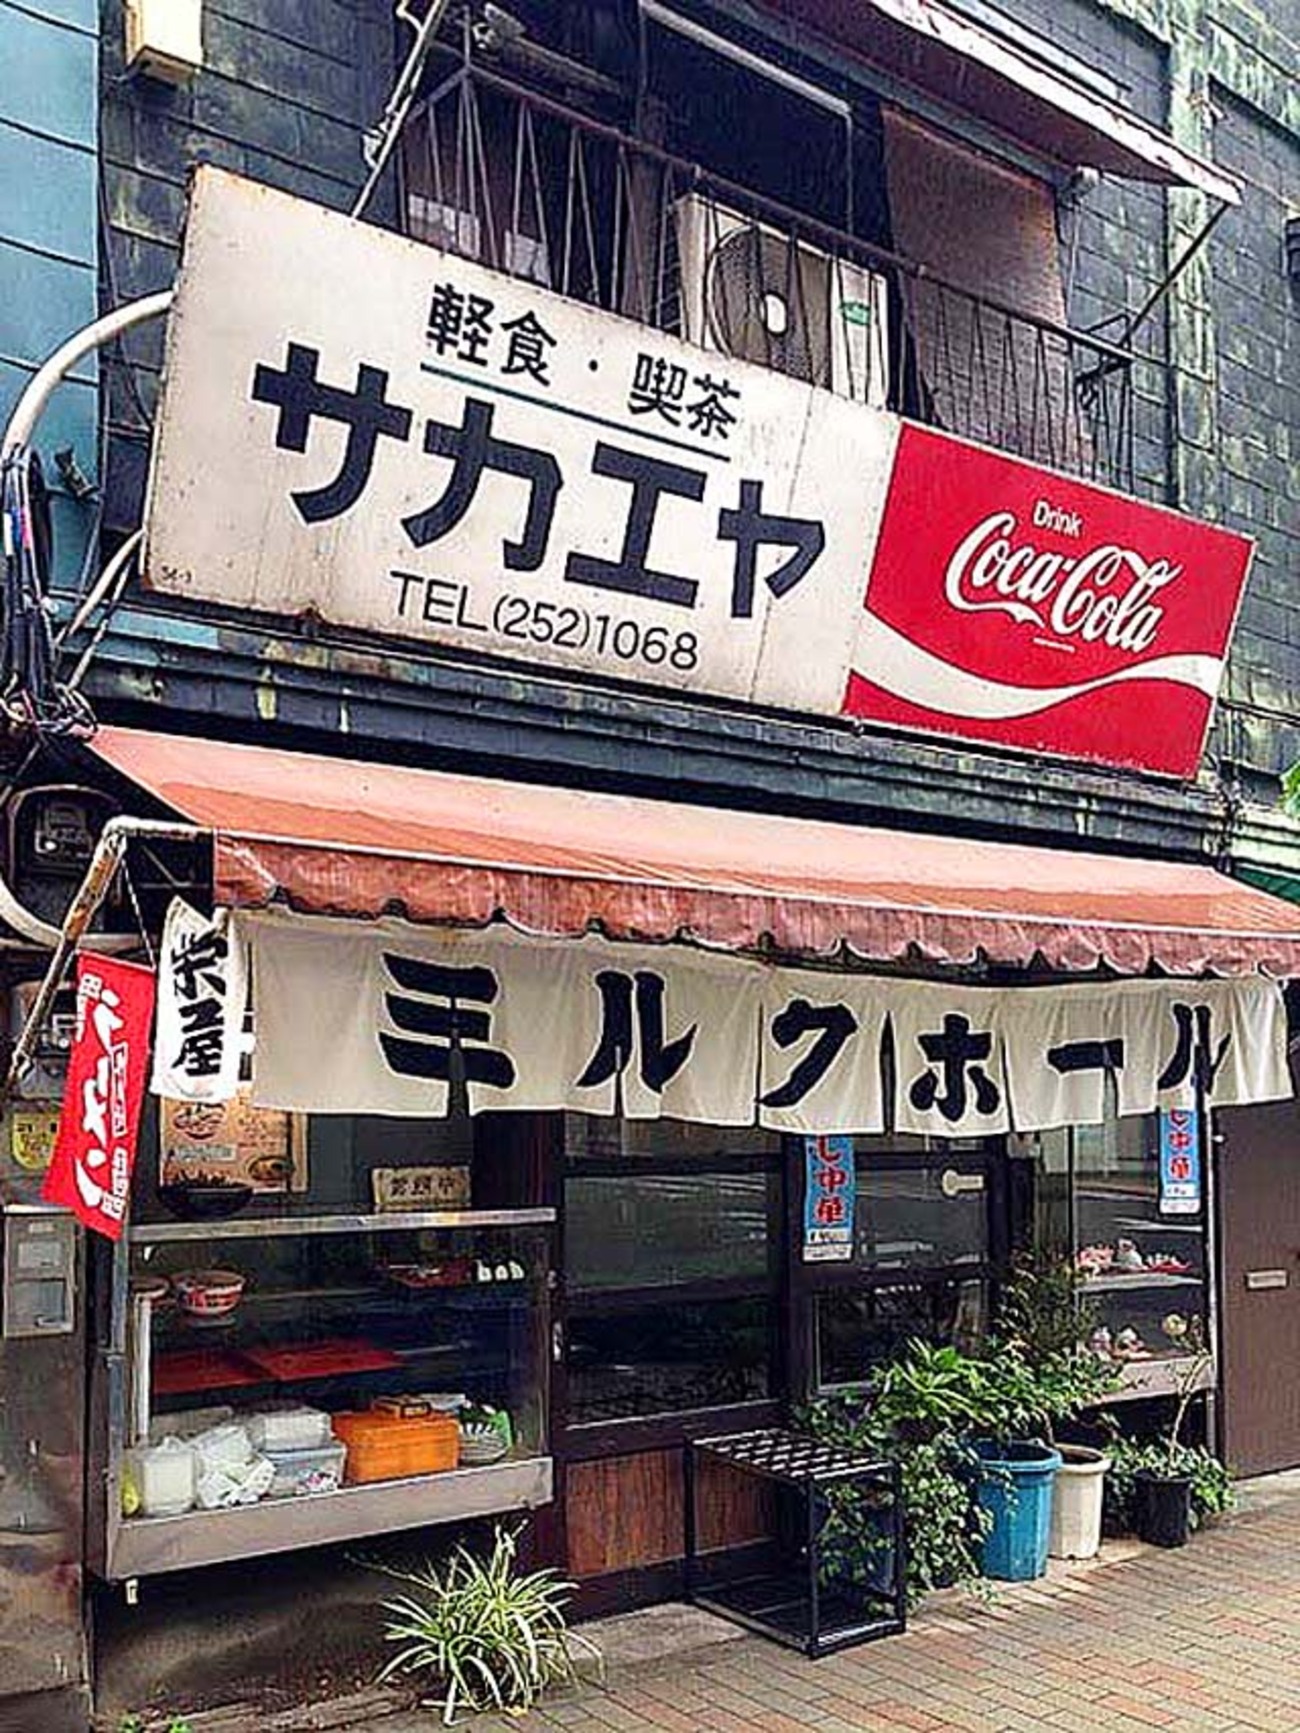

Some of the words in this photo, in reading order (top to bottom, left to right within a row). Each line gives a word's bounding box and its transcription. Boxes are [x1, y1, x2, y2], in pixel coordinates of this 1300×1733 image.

[425, 282, 742, 440] 軽食・喫茶
[250, 340, 827, 619] サカエヤ
[1033, 500, 1083, 538] Drink
[945, 512, 1184, 653] Coca-Cola
[377, 951, 1233, 1123] ミルクホール
